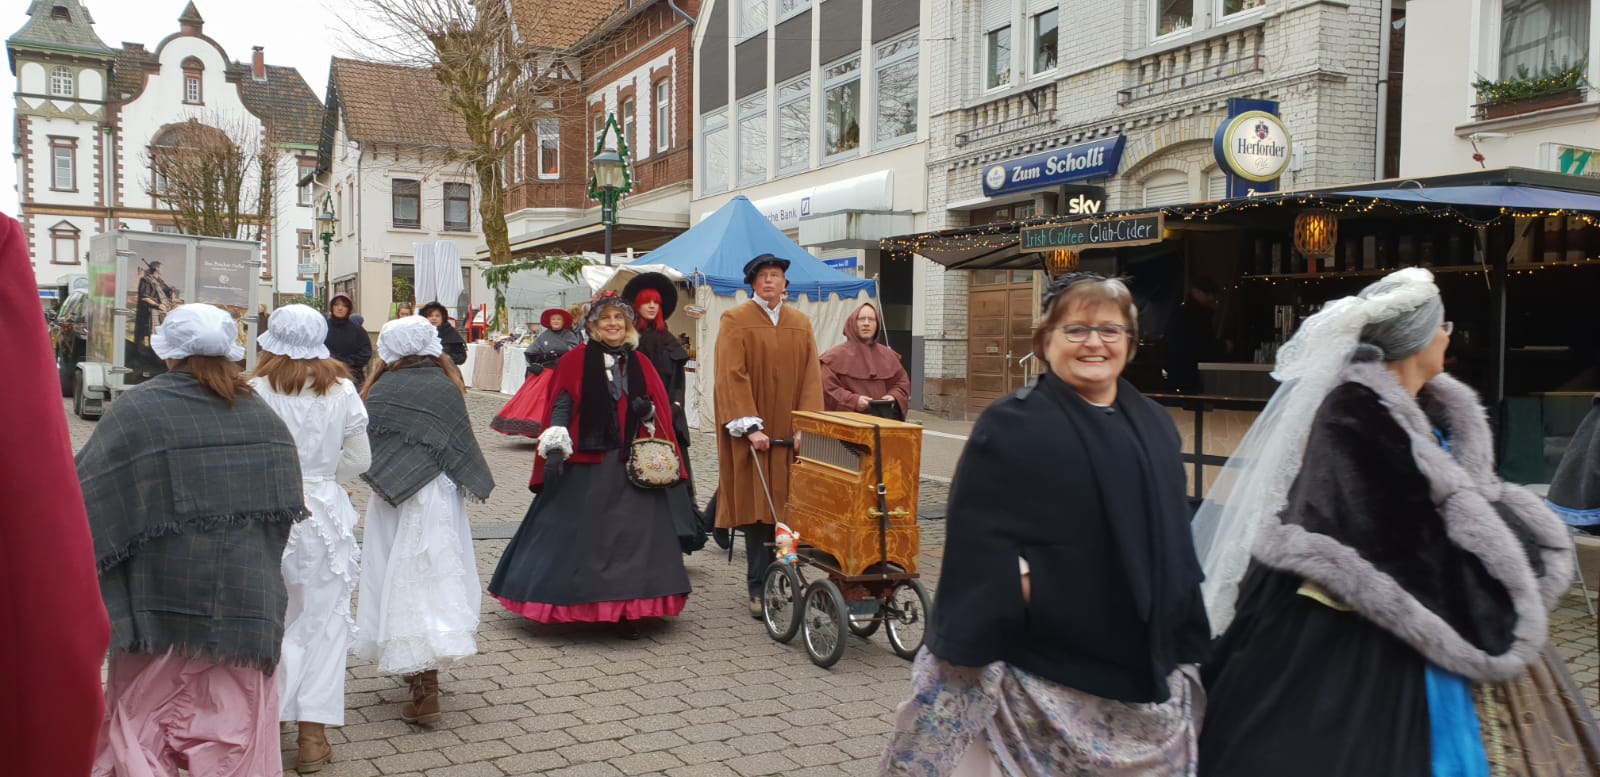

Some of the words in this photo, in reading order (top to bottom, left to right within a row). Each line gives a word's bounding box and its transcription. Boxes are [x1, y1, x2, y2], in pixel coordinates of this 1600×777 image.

[1238, 138, 1285, 158] Herforder
[1012, 165, 1041, 183] Zum
[1045, 147, 1105, 176] Scholli
[780, 208, 798, 220] Bank
[1069, 194, 1101, 214] sky
[1025, 229, 1046, 247] Irish
[1048, 227, 1085, 245] Coffee
[1089, 219, 1153, 243] Glüh-Cider
